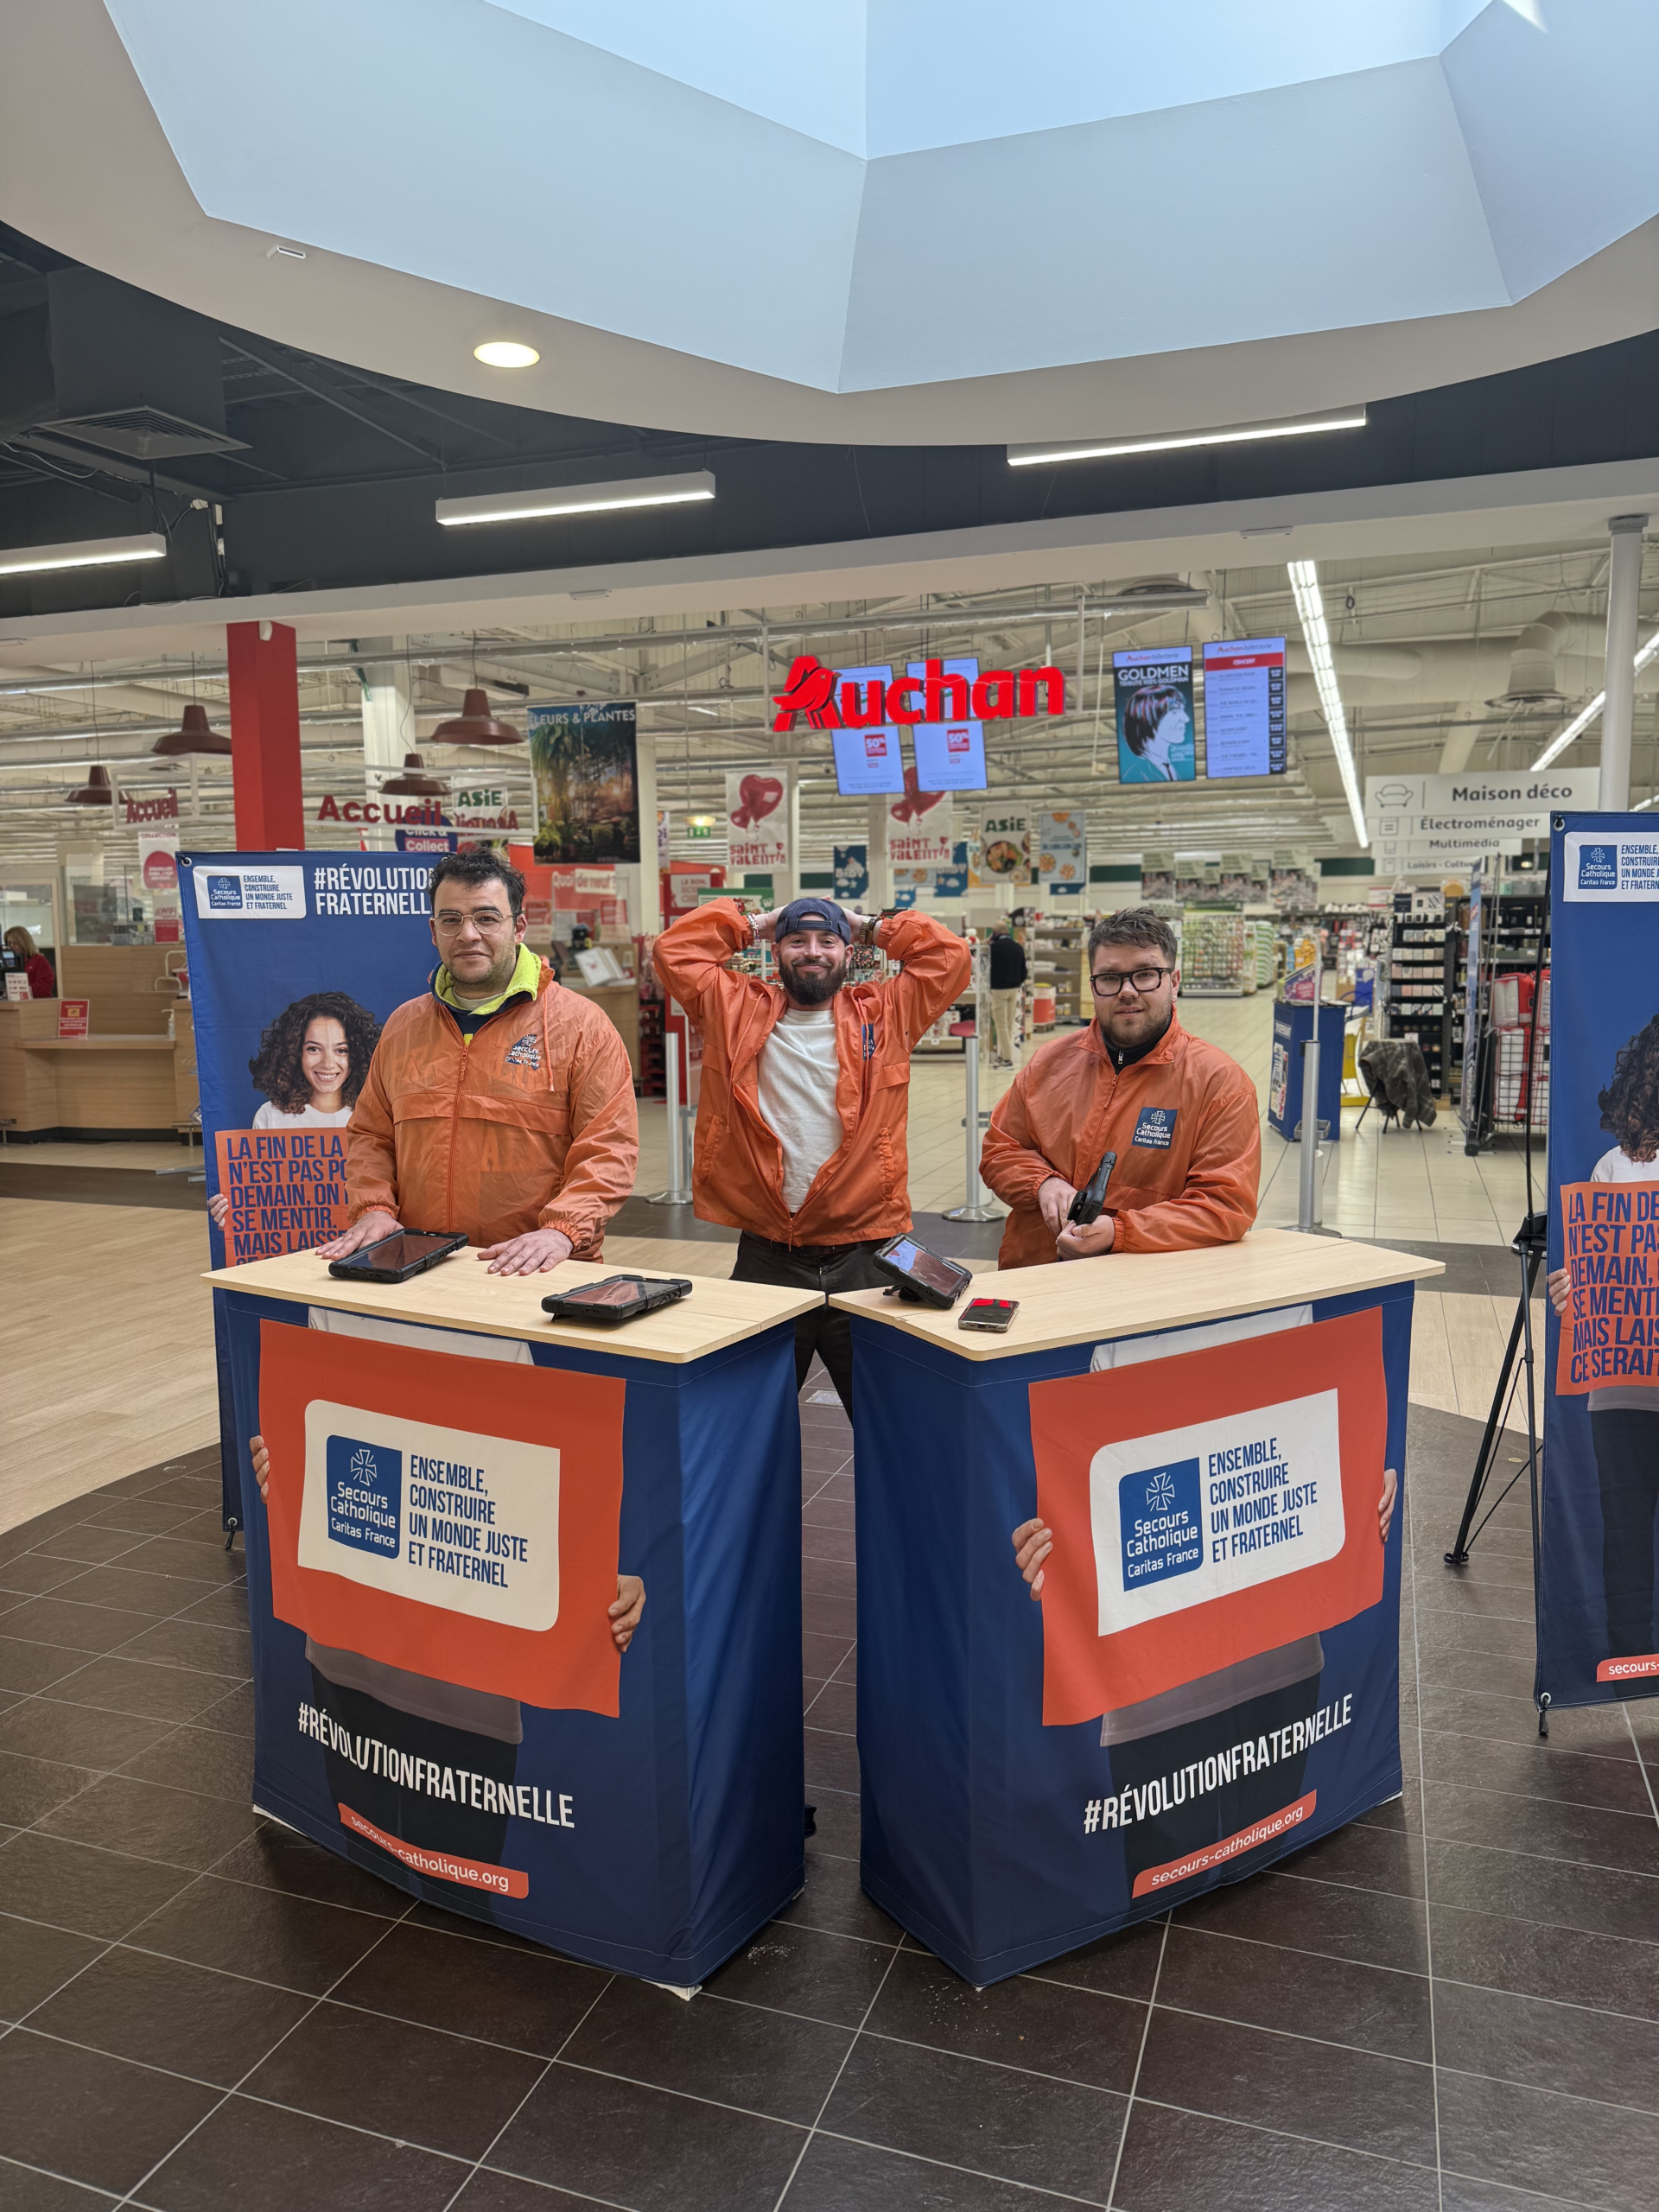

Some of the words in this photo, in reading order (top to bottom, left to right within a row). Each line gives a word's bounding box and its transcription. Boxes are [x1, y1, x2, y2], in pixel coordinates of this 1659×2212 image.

[1127, 653, 1152, 662] Auchan
[1244, 643, 1272, 652] billetterie
[1118, 664, 1189, 682] GOLDMEN
[772, 655, 1065, 732] Auchan
[573, 713, 581, 724] &
[583, 709, 636, 723] PLANTES
[1452, 785, 1522, 802] Maison
[1527, 783, 1573, 799] déco
[317, 795, 442, 827] Accueil
[1420, 815, 1541, 831] Électroménager
[405, 840, 449, 853] Collect
[1621, 844, 1658, 855] ENSEMBLE,
[1408, 861, 1437, 869] Loisirs
[1444, 860, 1474, 868] Cultu
[1621, 868, 1630, 878] UN
[1631, 868, 1656, 878] MONDE
[553, 871, 575, 887] Quoi
[576, 874, 588, 888] de
[589, 874, 611, 889] neuf
[1621, 880, 1630, 889] ET
[1630, 880, 1659, 889] FRATERN
[315, 893, 432, 915] FRATERNELL
[509, 1051, 542, 1061] atholique
[1135, 1136, 1153, 1145] Caritas
[1136, 1128, 1171, 1139] Catholique
[1141, 1122, 1168, 1132] Secours
[226, 1137, 252, 1160] LA
[256, 1136, 286, 1159] FIN
[291, 1135, 315, 1159] DE
[320, 1135, 344, 1158] LA
[228, 1160, 283, 1185] N'EST
[289, 1160, 323, 1183] PAS
[231, 1185, 311, 1209] DEMAIN,
[315, 1184, 339, 1205] ON
[1568, 1192, 1586, 1224] LA
[1592, 1192, 1631, 1223] FIN
[1637, 1191, 1659, 1221] DE
[232, 1210, 256, 1232] SE
[261, 1207, 337, 1231] MENTIR.
[233, 1232, 283, 1256] MAIS
[1568, 1224, 1626, 1256] N'EST
[1630, 1223, 1659, 1253] PA
[1571, 1255, 1653, 1289] DEMAIN,
[1573, 1288, 1586, 1321] SE
[1589, 1286, 1659, 1316] MENTI
[1573, 1317, 1610, 1353] MAIS
[1570, 1351, 1589, 1383] CE
[1208, 1437, 1281, 1478] ENSEMBLE,
[410, 1454, 488, 1497] ENSEMBLE,
[1210, 1462, 1289, 1505] CONSTRUIRE
[337, 1481, 388, 1510] Secours
[410, 1484, 496, 1525] CONSTRUIRE
[1211, 1508, 1230, 1534] UN
[1233, 1493, 1278, 1529] MONDE
[1281, 1481, 1318, 1515] JUSTE
[330, 1497, 396, 1529] Catholique
[1135, 1510, 1189, 1538] Secours
[331, 1517, 362, 1539] Caritas
[365, 1529, 396, 1548] France
[409, 1512, 428, 1538] UN
[432, 1517, 481, 1552] MONDE
[485, 1530, 528, 1563] JUSTE
[1126, 1526, 1198, 1558] Catholique
[1211, 1537, 1229, 1564] ET
[1231, 1515, 1303, 1557] FRATERNEL
[408, 1541, 425, 1567] ET
[428, 1546, 508, 1588] FRATERNEL
[1128, 1557, 1164, 1578] Caritas
[1166, 1548, 1199, 1567] France
[297, 1701, 575, 1828] #RÉVOLUTIONFRATERNELLE
[1084, 1693, 1353, 1834] #RÉVOLUTIONFRATERNELLE
[351, 1815, 510, 1892] secours-catholique.org
[1151, 1804, 1304, 1886] secours-catholique.org
